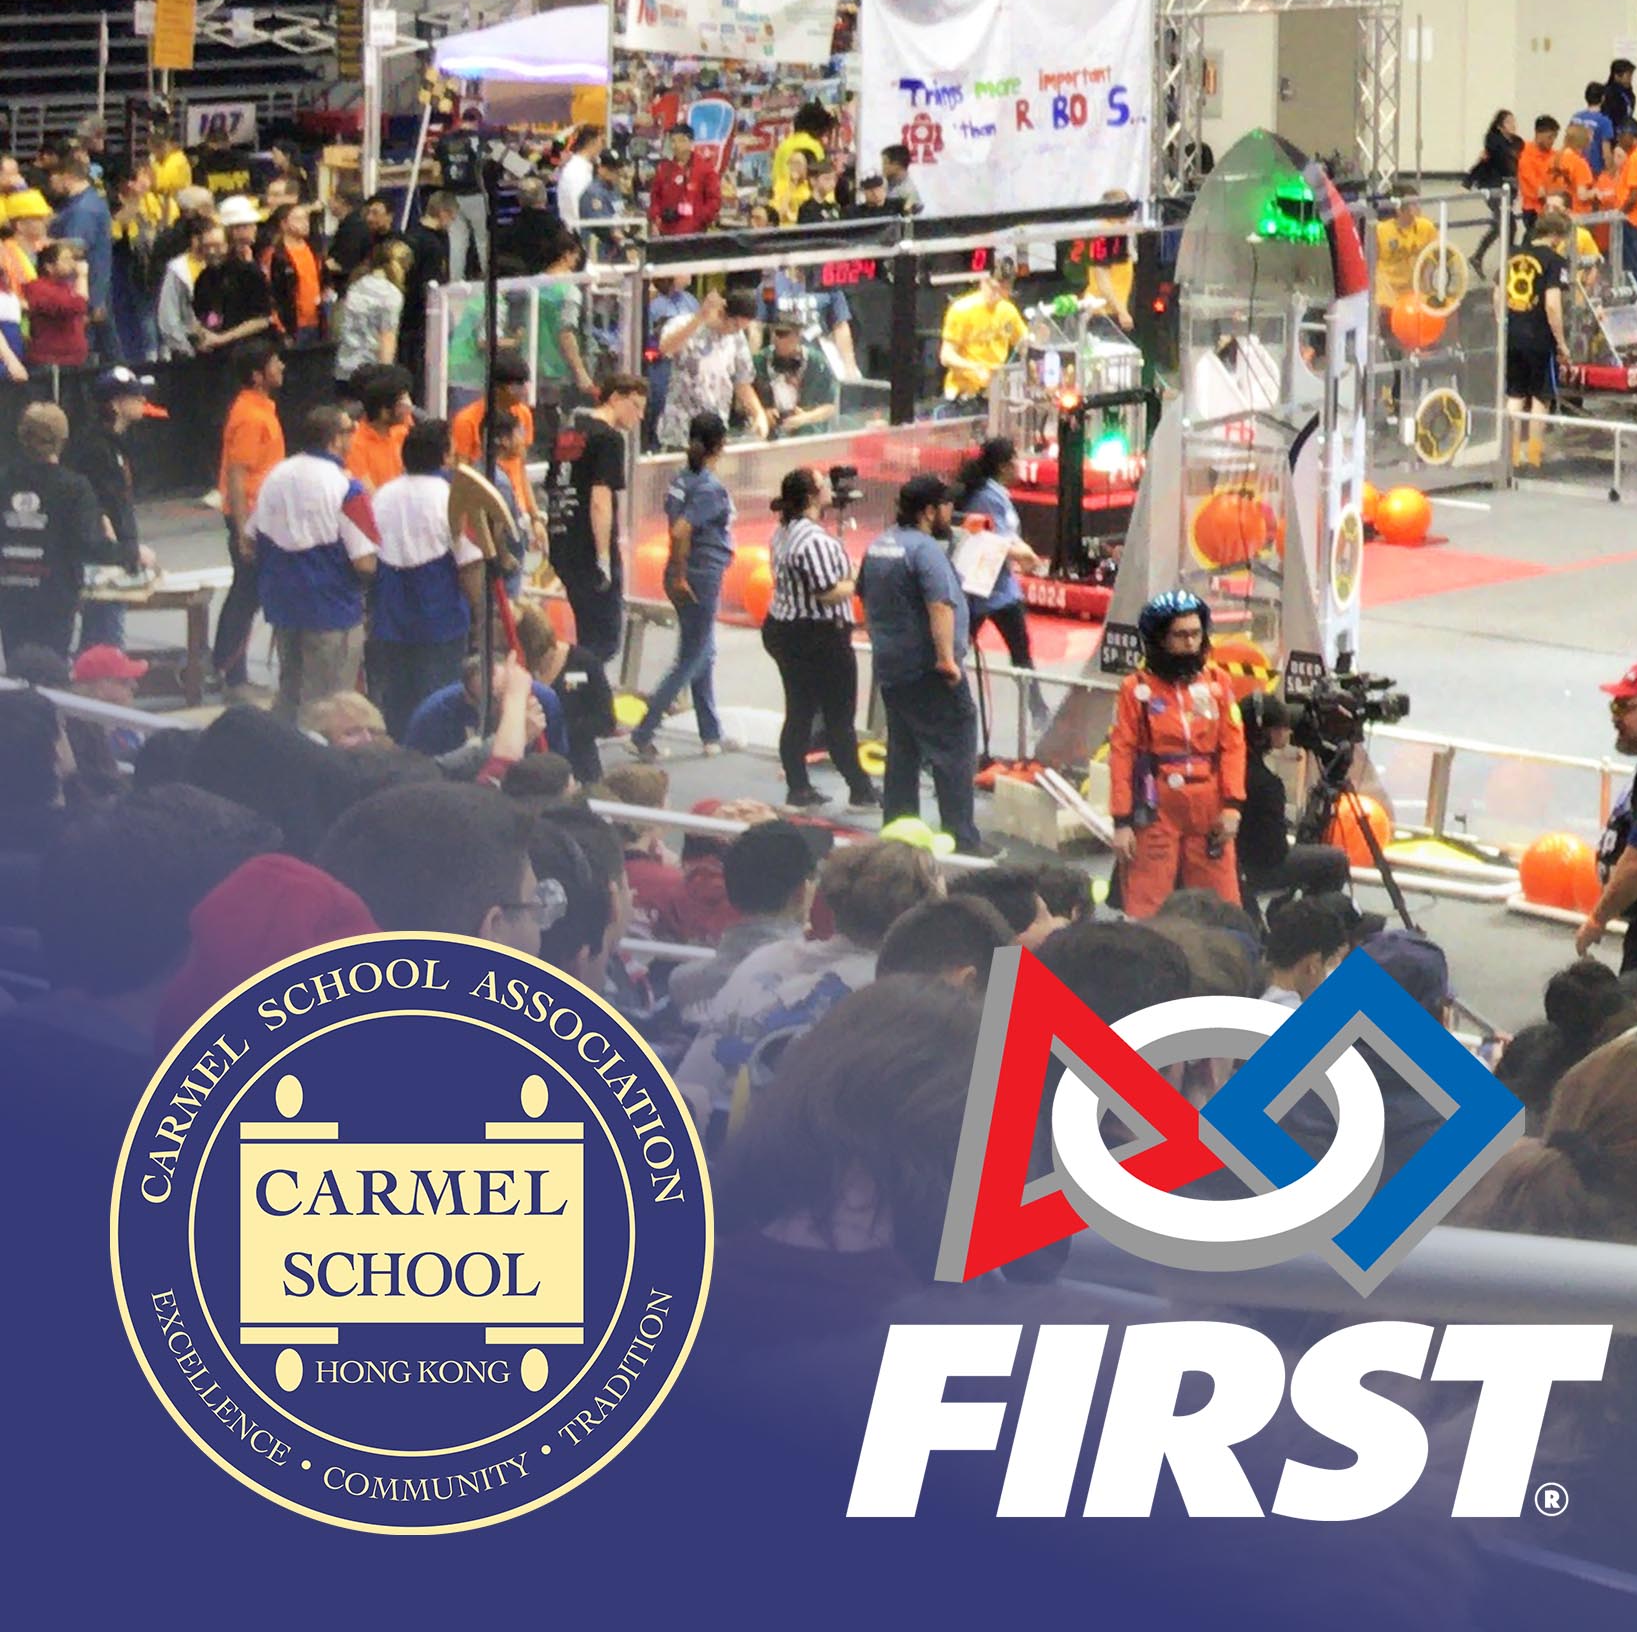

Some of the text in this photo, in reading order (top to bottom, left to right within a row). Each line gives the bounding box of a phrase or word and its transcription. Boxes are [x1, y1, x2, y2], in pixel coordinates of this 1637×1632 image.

[898, 77, 964, 111] Things
[974, 76, 1022, 99] more
[960, 118, 997, 140] than
[821, 260, 877, 287] 6024
[1027, 582, 1067, 609] 6024
